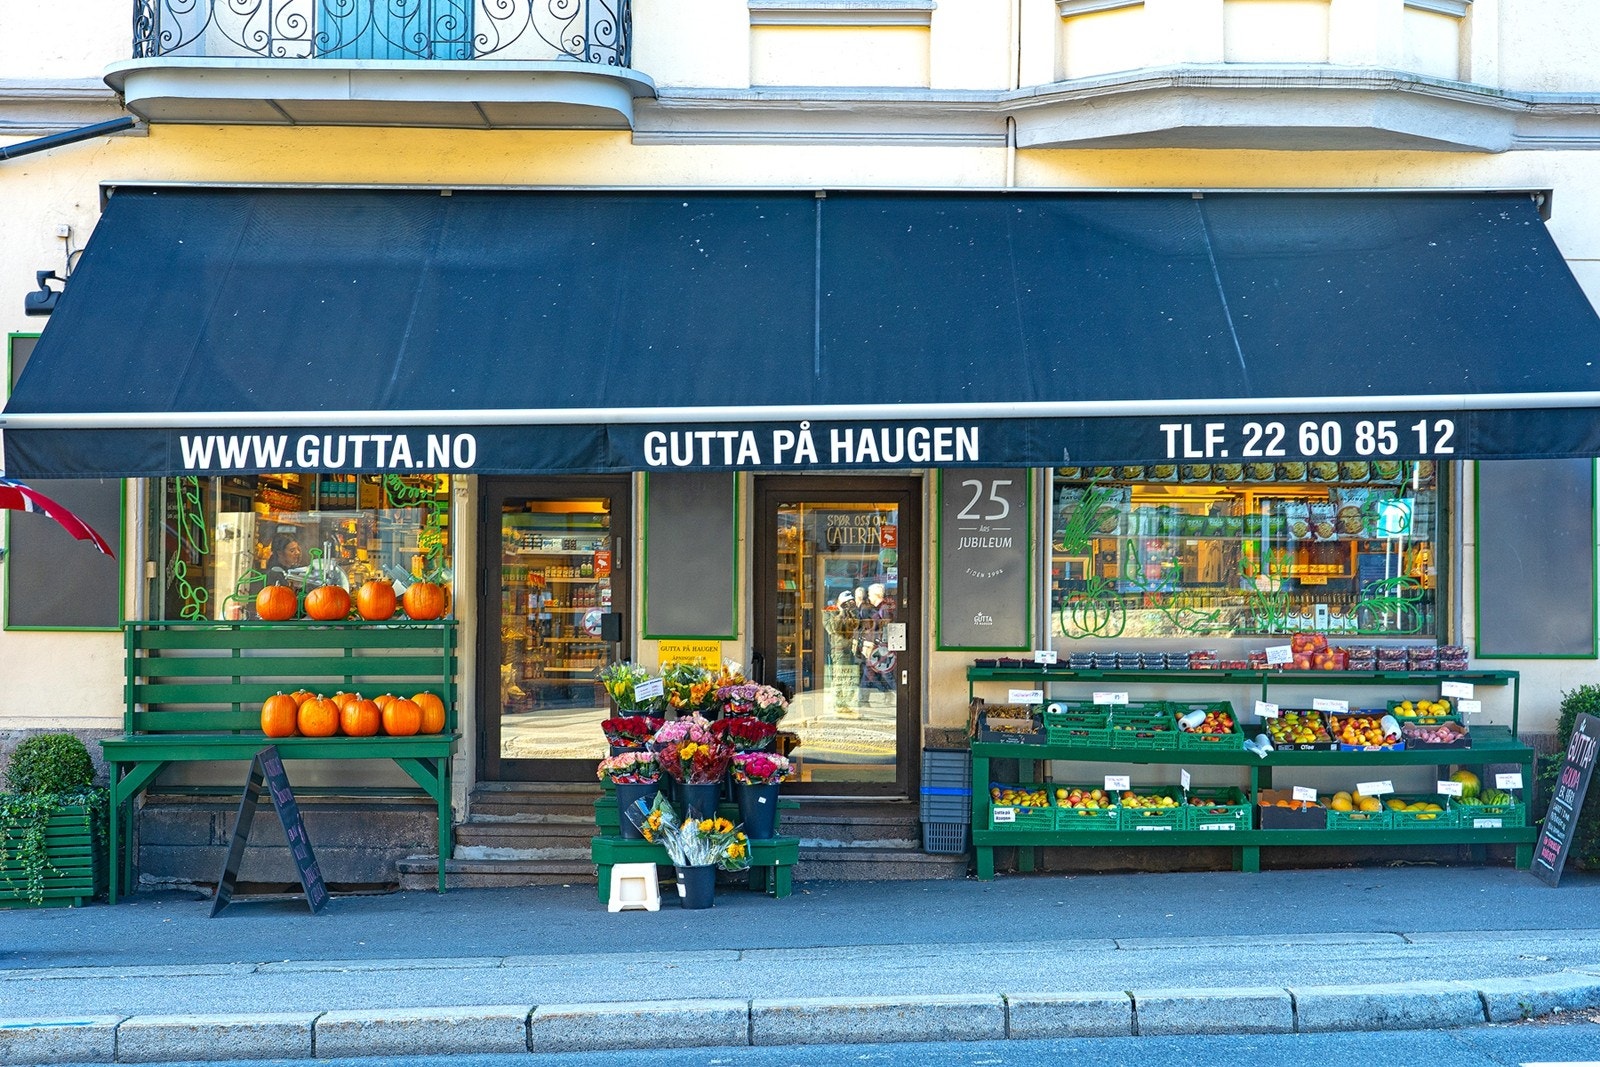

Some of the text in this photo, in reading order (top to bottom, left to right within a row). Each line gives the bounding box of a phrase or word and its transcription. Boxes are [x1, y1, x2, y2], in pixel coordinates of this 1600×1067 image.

[180, 434, 477, 469] WWW.GUTTA.NO
[643, 420, 980, 468] GUTTA PÅ HAUGEN
[1159, 419, 1455, 459] TLF. 22 60 85 12
[957, 479, 1013, 521] 25
[826, 514, 850, 527] SPØR
[854, 515, 870, 527] OSS
[826, 526, 882, 545] CATERIN
[957, 536, 1012, 550] JUBILEUM
[683, 644, 691, 652] PÅ
